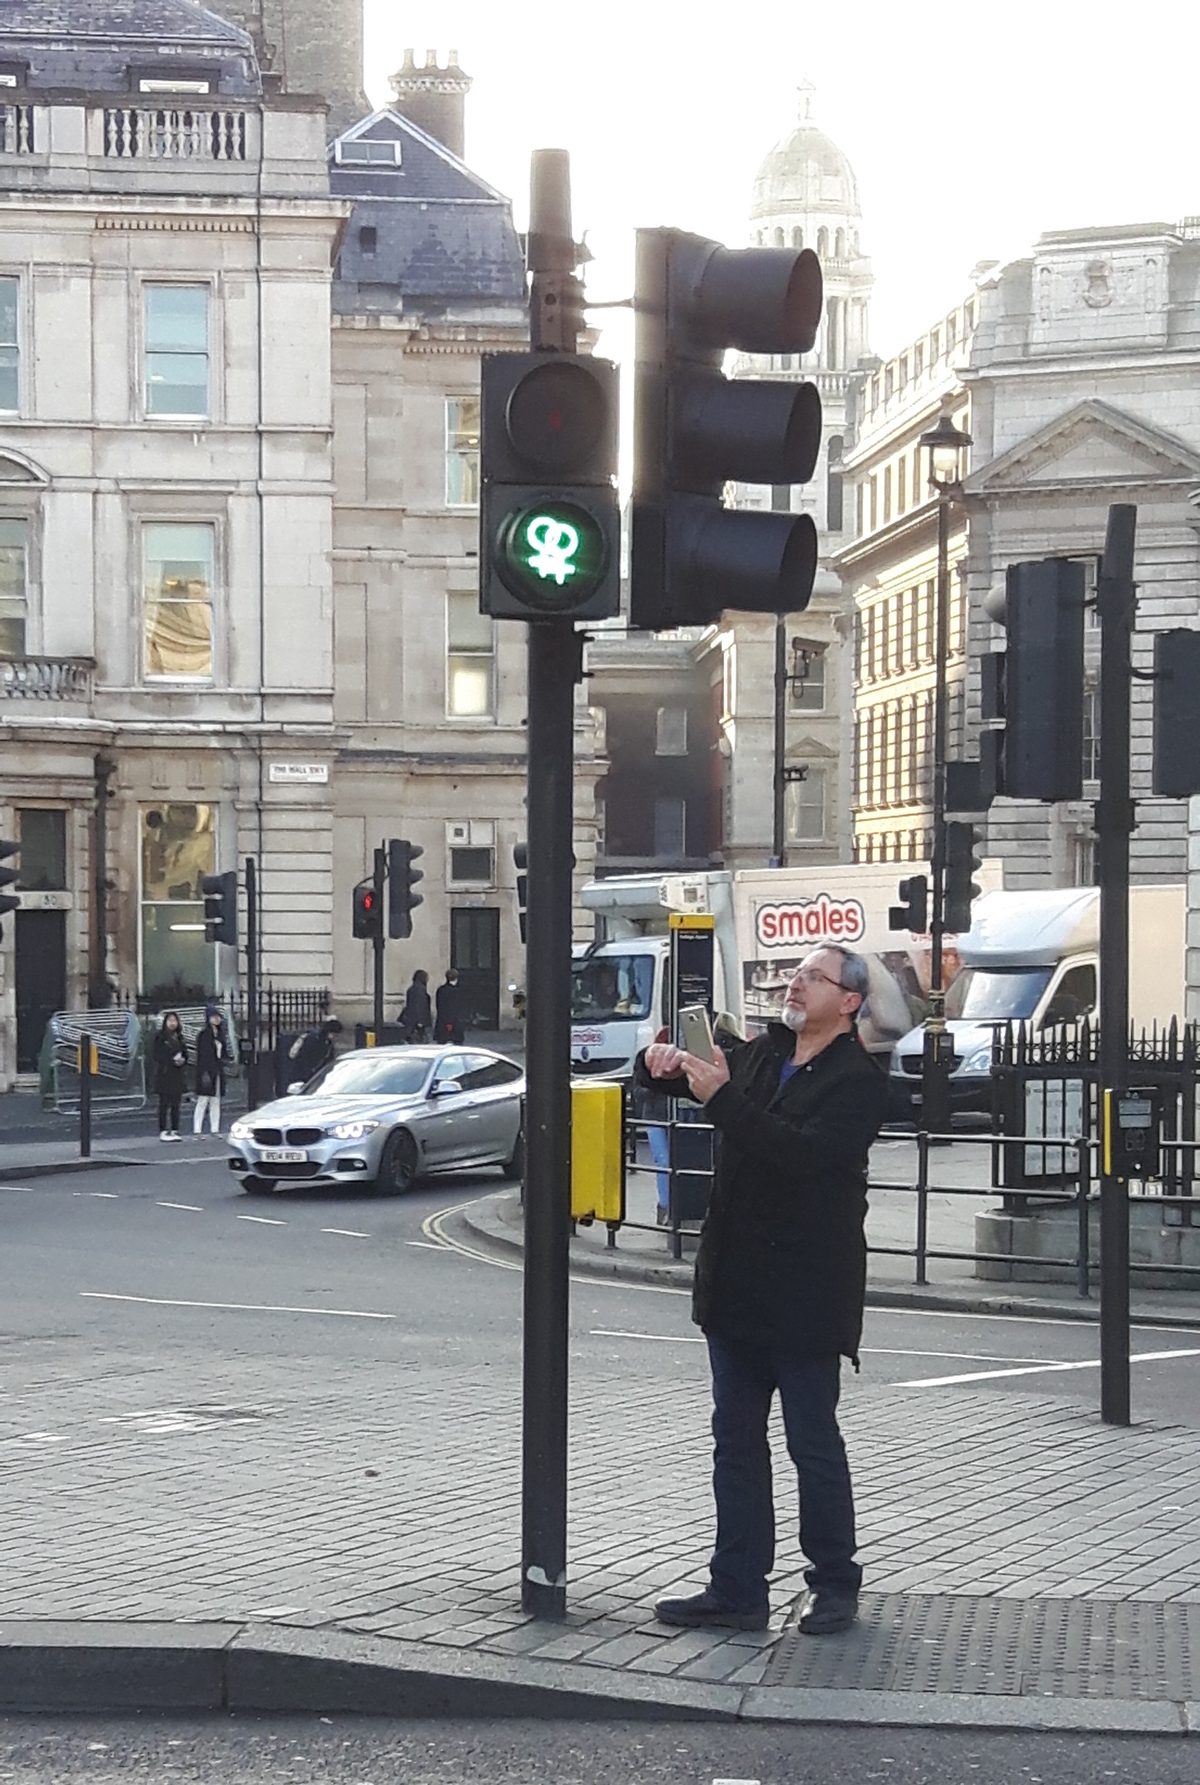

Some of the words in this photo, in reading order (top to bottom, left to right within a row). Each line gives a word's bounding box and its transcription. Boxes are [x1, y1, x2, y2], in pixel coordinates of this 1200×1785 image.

[289, 766, 307, 774] MALL
[762, 902, 860, 939] smales
[572, 1031, 602, 1043] males
